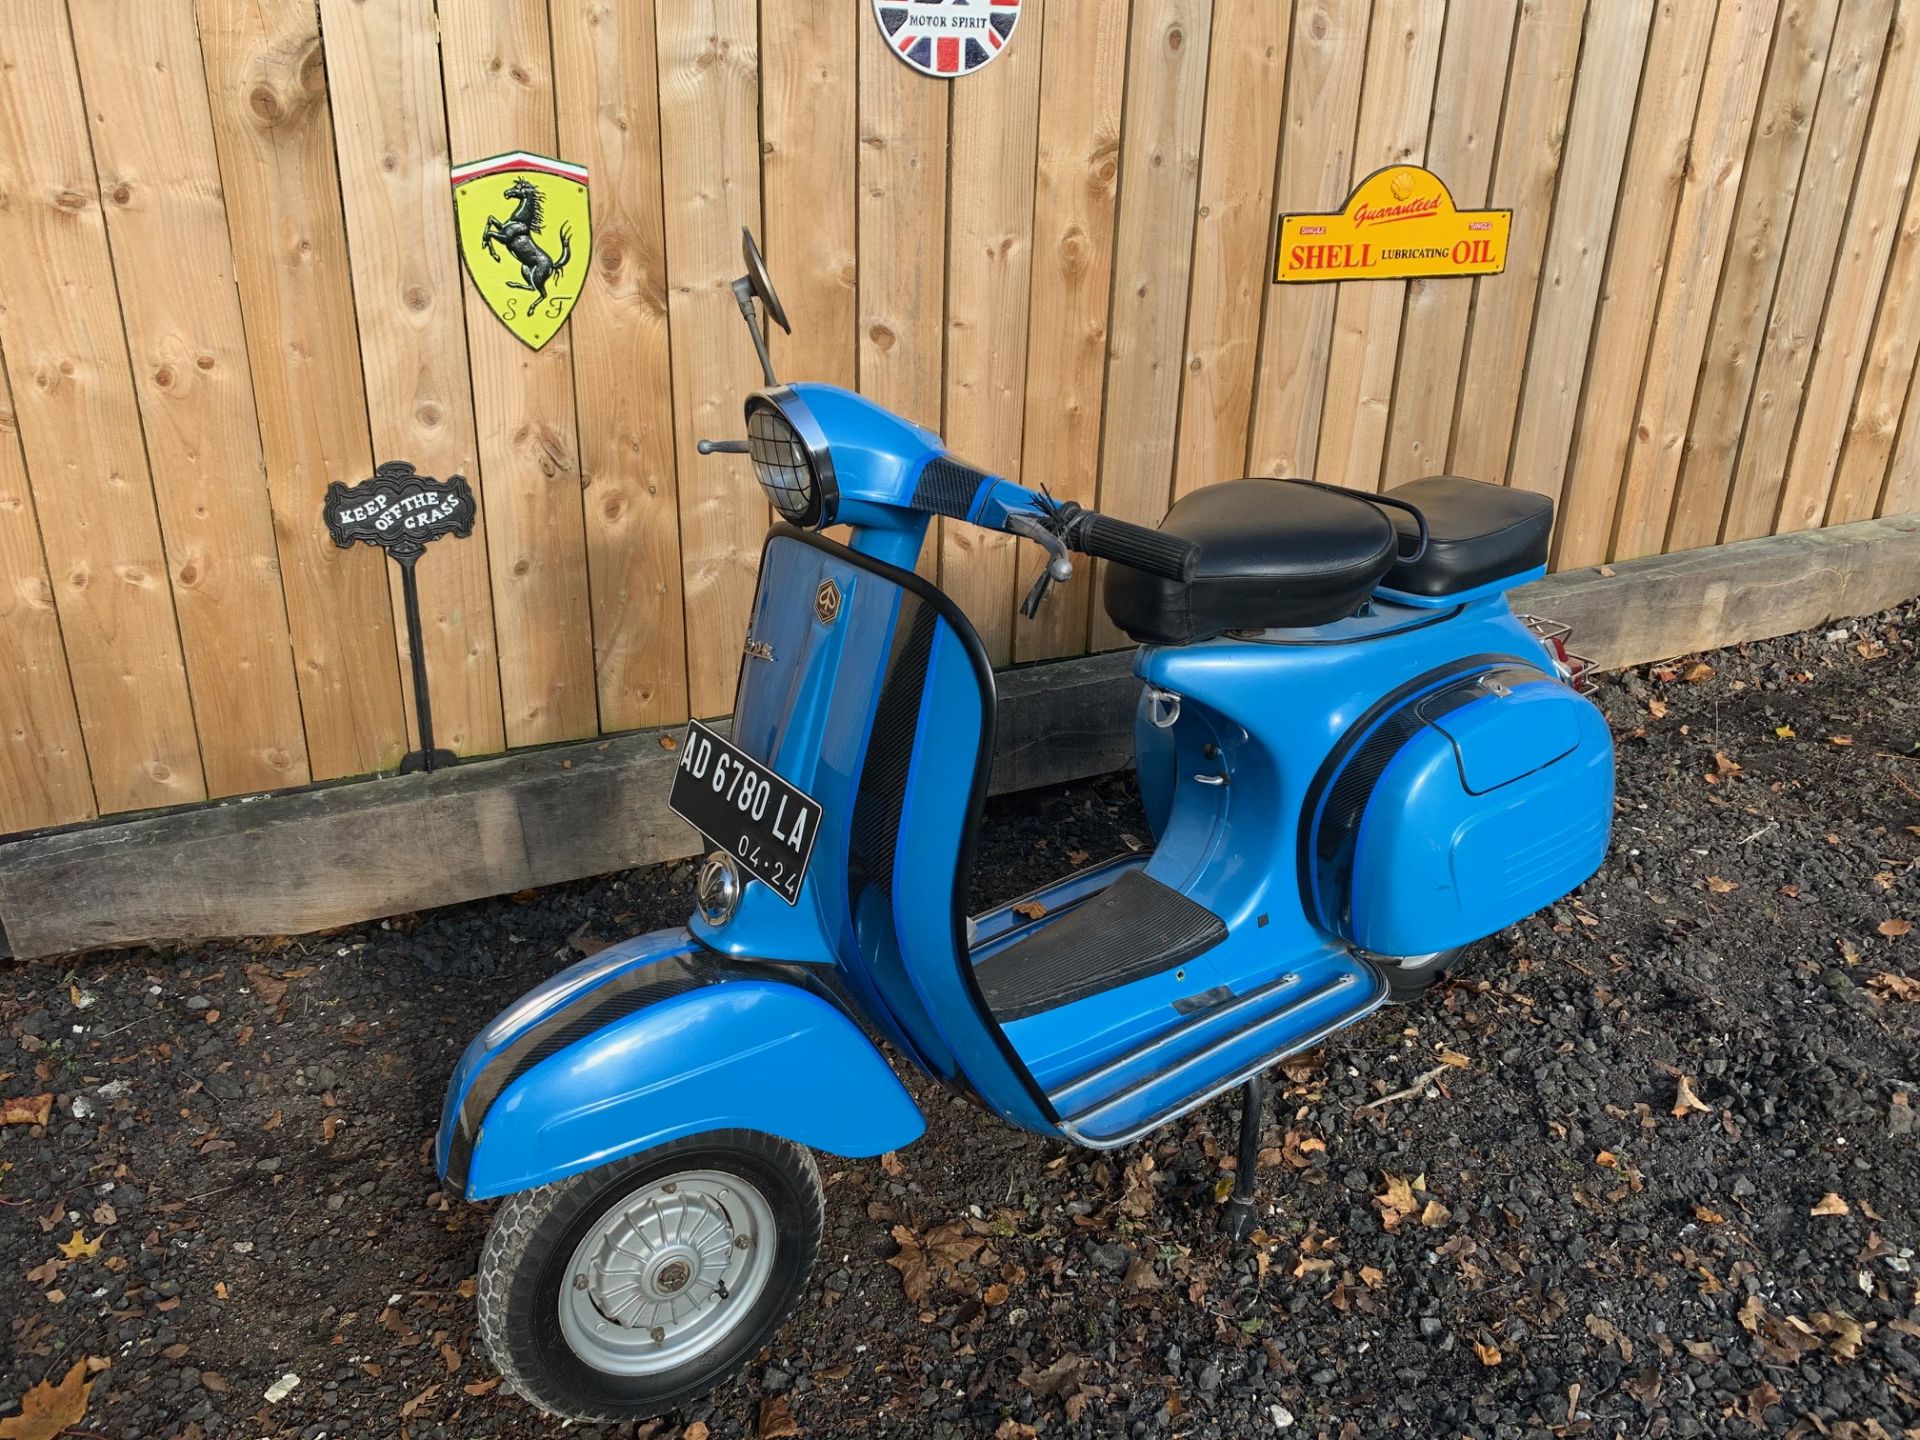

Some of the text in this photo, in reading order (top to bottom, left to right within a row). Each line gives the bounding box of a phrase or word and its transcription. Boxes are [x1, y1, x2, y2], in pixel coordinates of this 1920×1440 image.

[909, 14, 988, 29] MOTOR SPIRIT
[1353, 193, 1442, 228] Guaranteed
[1289, 240, 1496, 270] SHELL LUBRICATING OIL
[339, 494, 387, 524] KEEP
[374, 492, 440, 531] OFF THE
[404, 494, 460, 530] GRASS
[680, 731, 808, 853] AD 6780 LA
